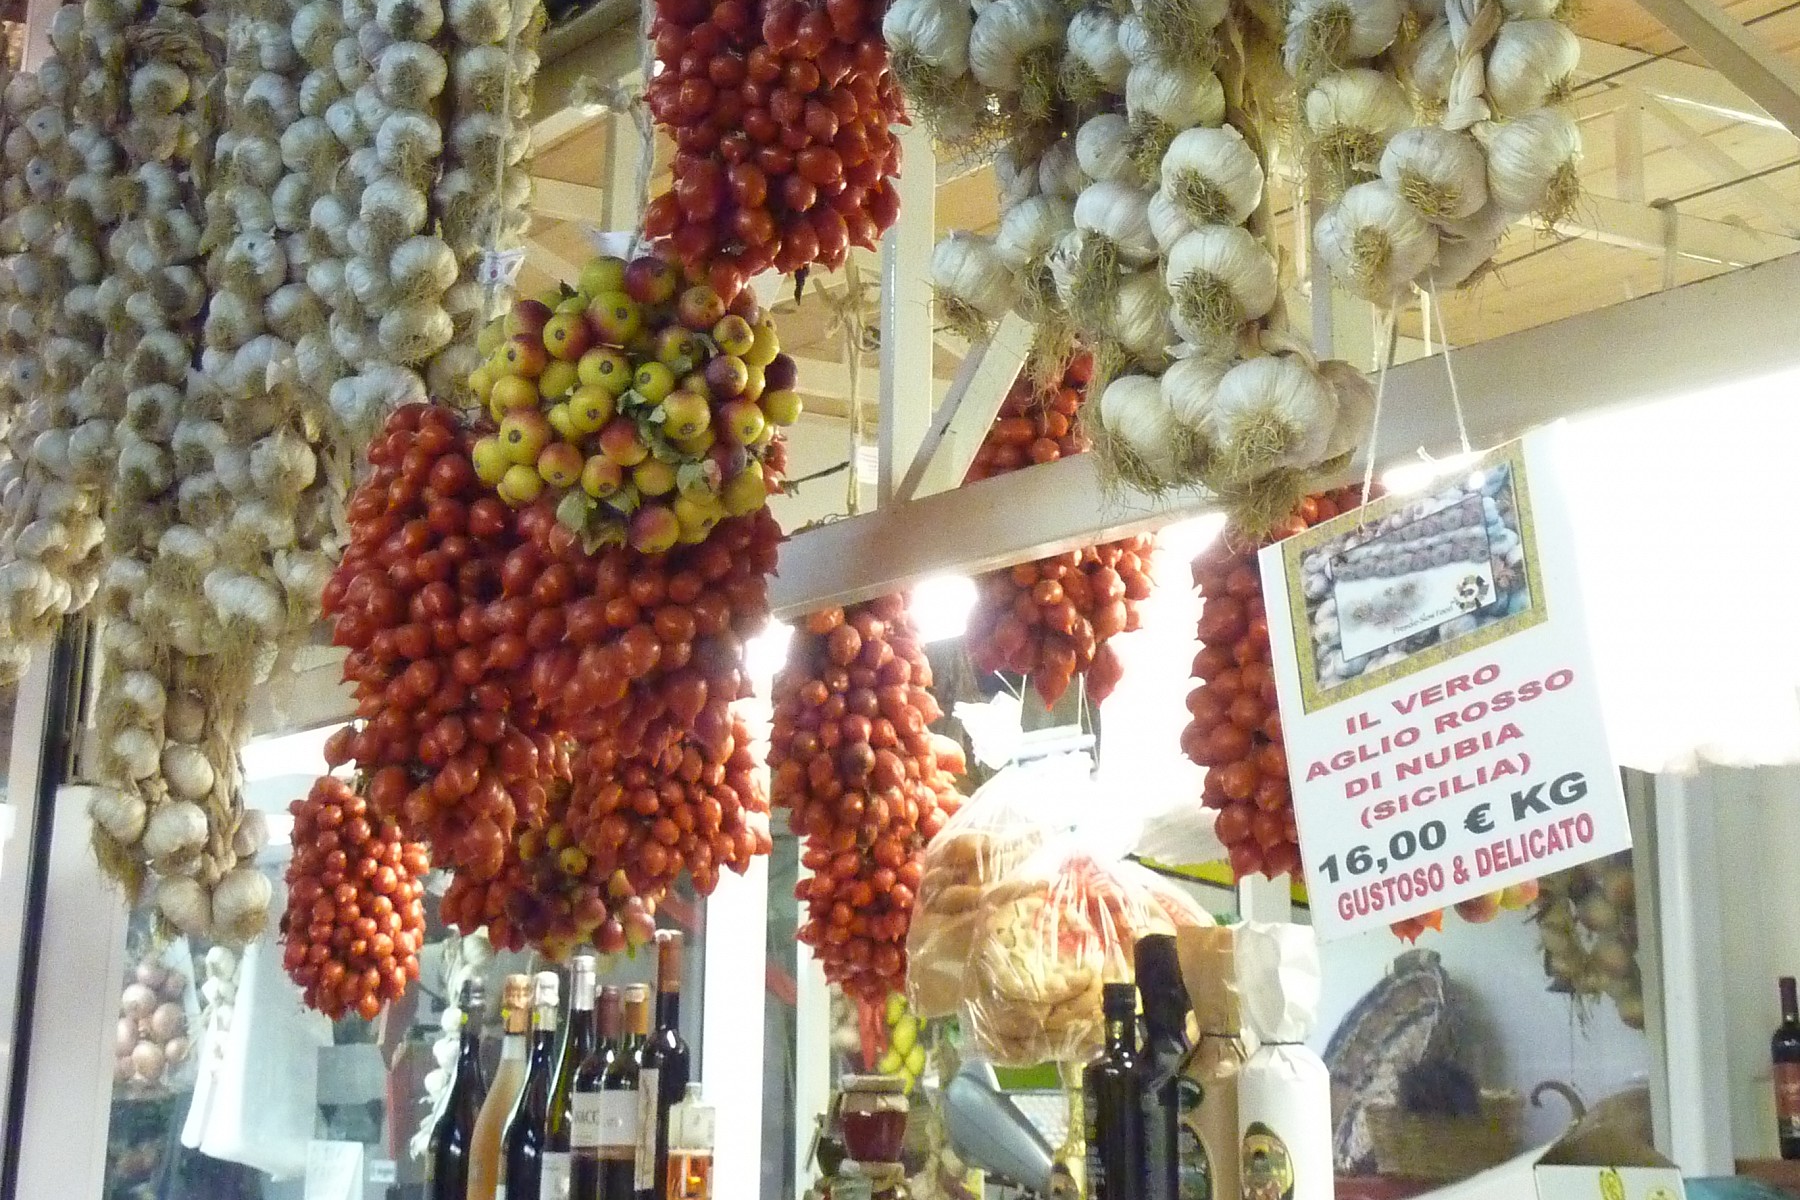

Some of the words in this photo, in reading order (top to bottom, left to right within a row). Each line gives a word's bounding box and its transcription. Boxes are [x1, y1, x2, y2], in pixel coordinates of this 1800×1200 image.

[1306, 726, 1421, 782] AGLIO
[1434, 668, 1574, 735] ROSSO
[1345, 712, 1381, 736] IL
[1391, 663, 1501, 715] VERO
[1345, 771, 1381, 799] DI
[1395, 722, 1525, 781] NUBIA
[1360, 752, 1532, 830] (SICILIA)
[1318, 820, 1447, 884] 16,00
[1463, 802, 1495, 835] €
[1510, 771, 1588, 822] KG
[1338, 862, 1445, 921] GUSTOSO
[1452, 855, 1470, 885] &
[1474, 812, 1594, 878] DELICATO
